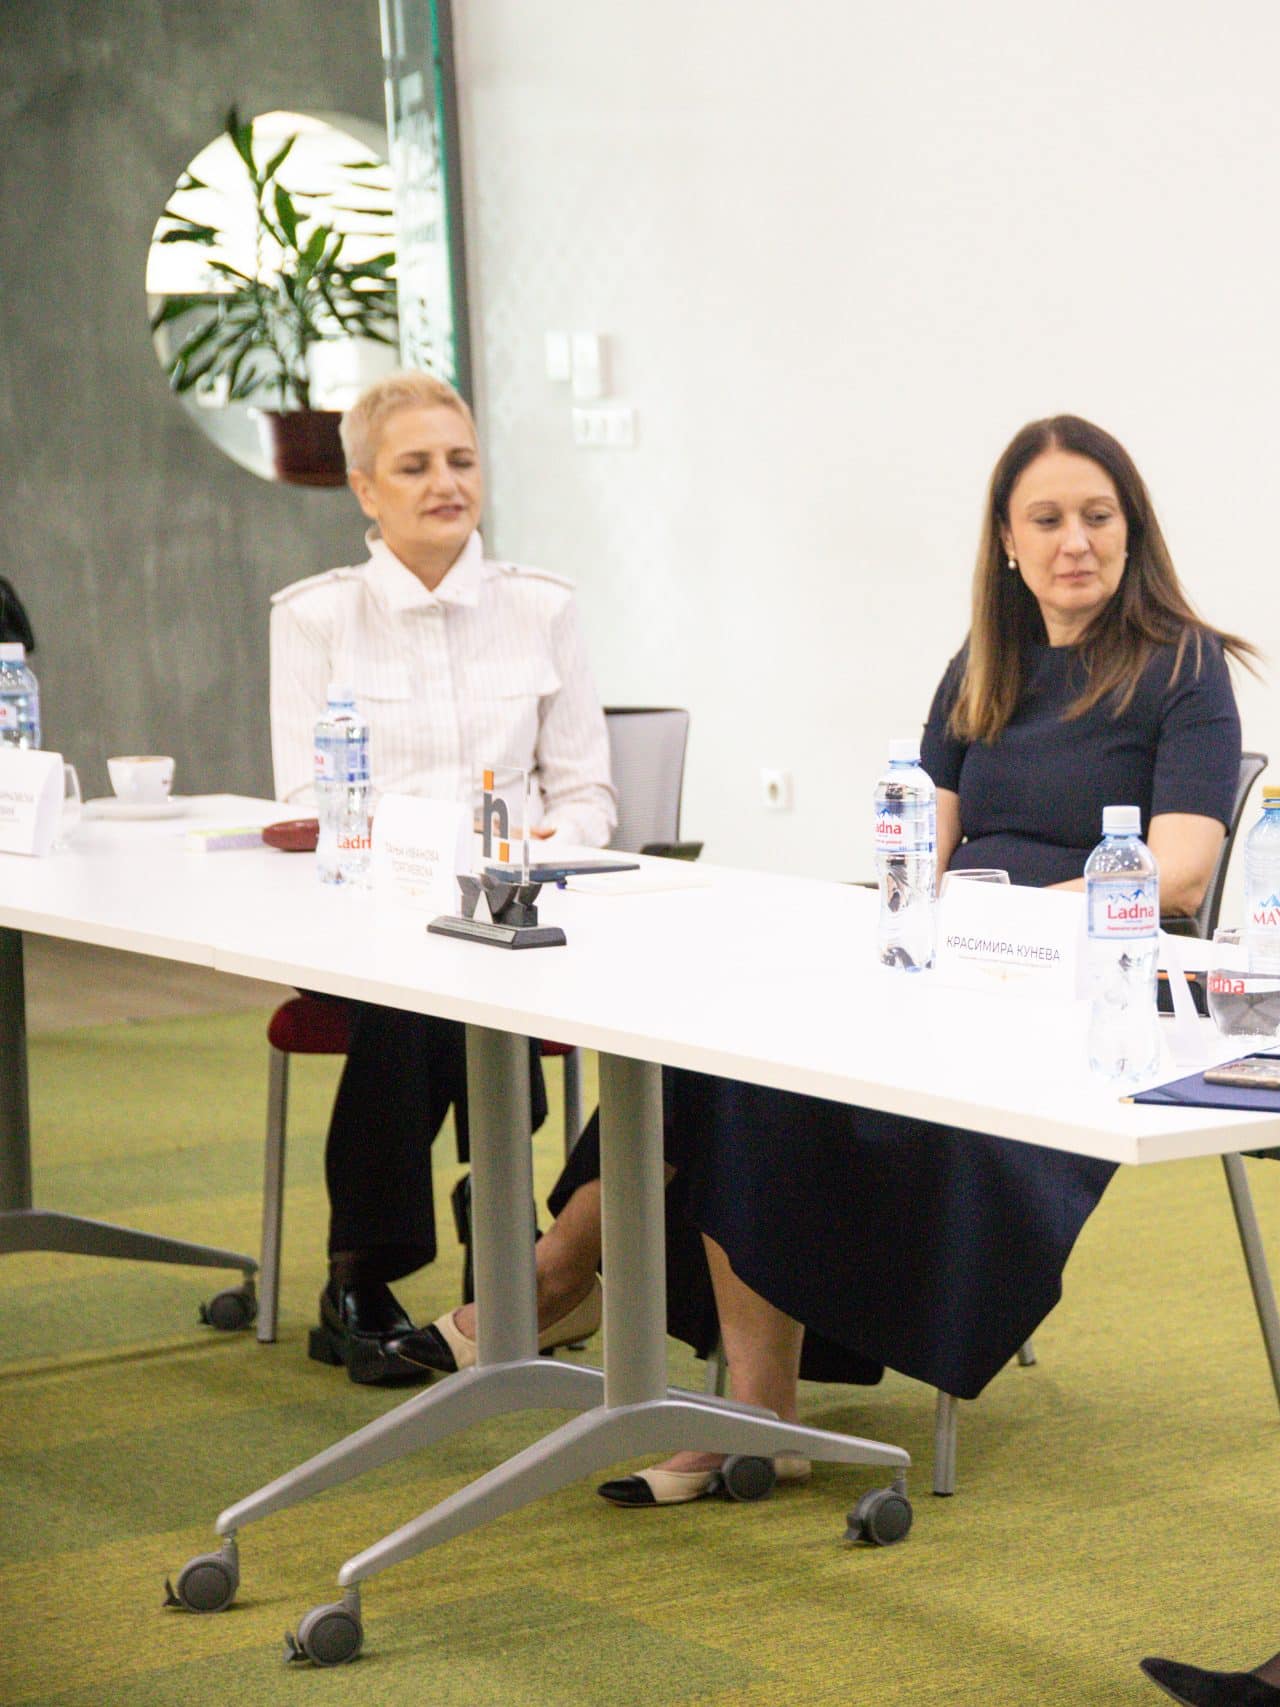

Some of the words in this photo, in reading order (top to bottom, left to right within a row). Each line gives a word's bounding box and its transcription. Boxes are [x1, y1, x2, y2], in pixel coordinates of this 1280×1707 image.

[874, 820, 902, 834] adna
[338, 834, 372, 849] Ladn
[1107, 903, 1154, 919] Ladna
[946, 935, 1014, 954] КРАСИМИРА
[1016, 943, 1061, 961] КУНЕВА
